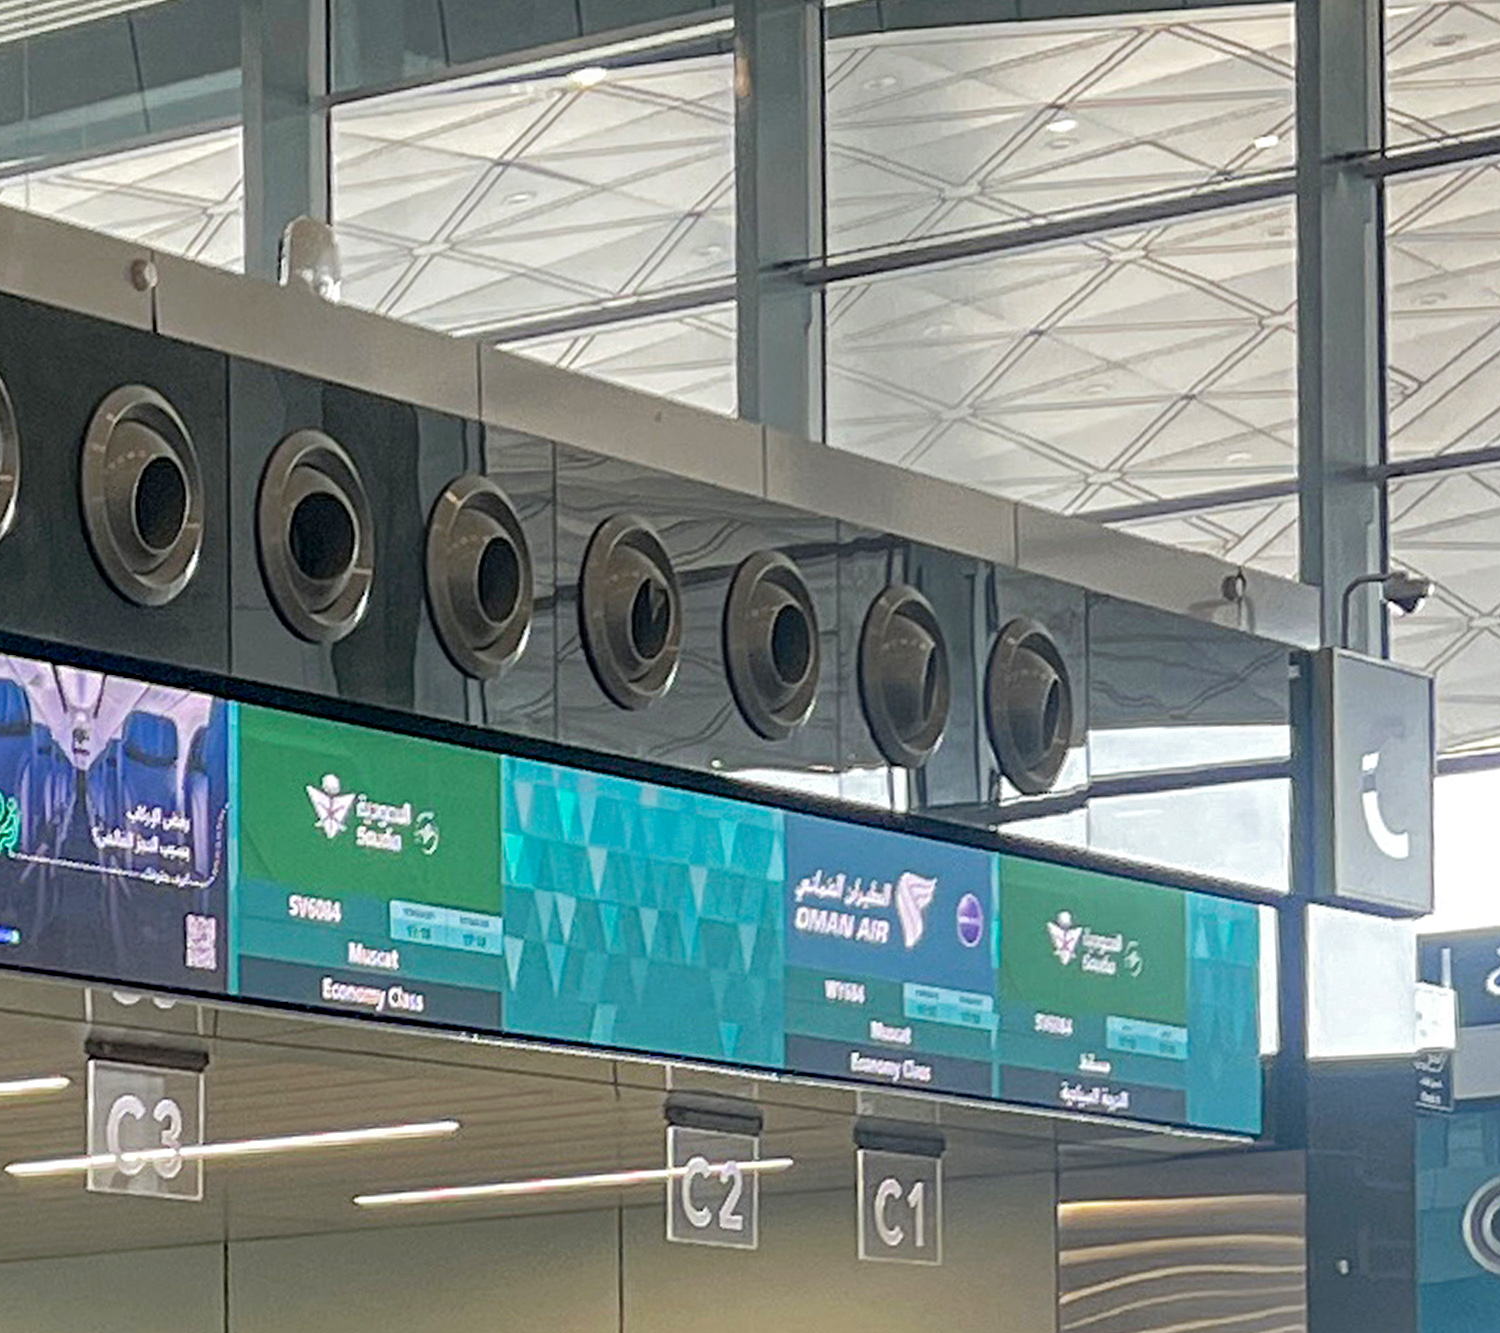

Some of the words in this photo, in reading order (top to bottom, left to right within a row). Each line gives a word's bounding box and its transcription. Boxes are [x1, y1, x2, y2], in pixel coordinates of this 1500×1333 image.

[795, 906, 855, 940] OMAN
[856, 918, 889, 944] AIR
[105, 1094, 182, 1180] C3
[680, 1156, 745, 1231] C2
[874, 1178, 926, 1250] C1
